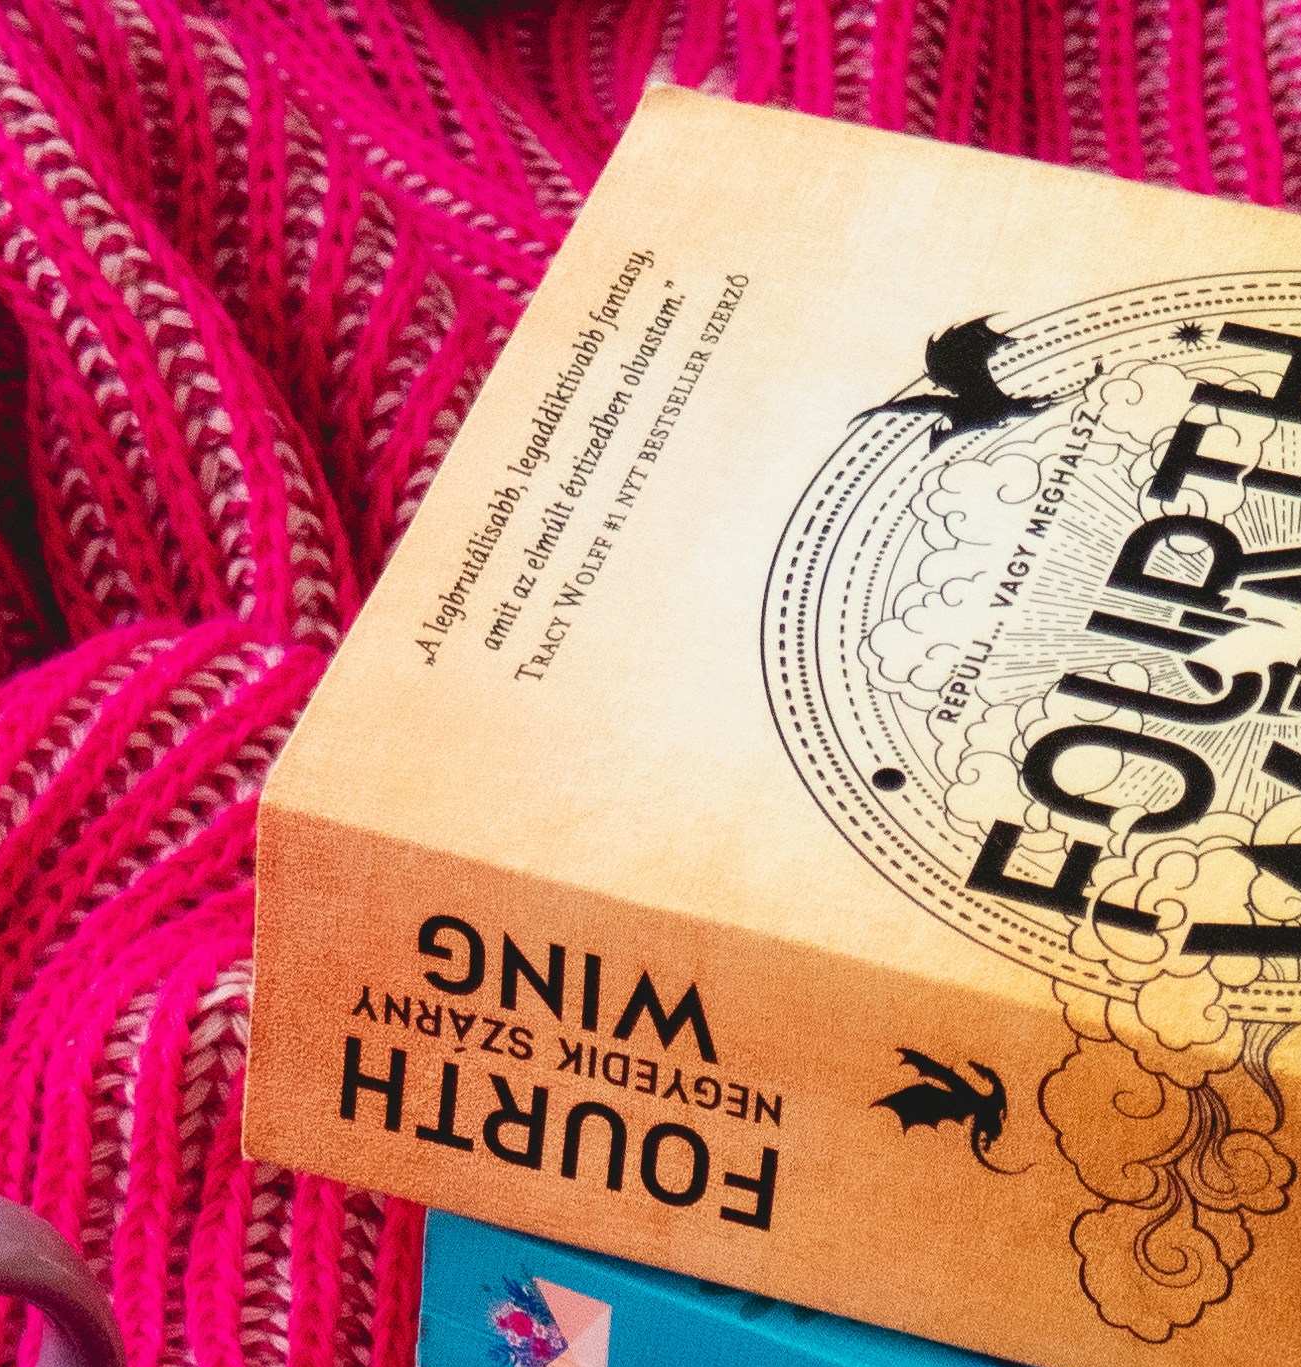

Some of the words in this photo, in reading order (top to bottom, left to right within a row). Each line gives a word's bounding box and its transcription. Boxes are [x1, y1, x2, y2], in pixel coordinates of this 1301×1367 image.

[699, 273, 750, 345] SZERZŐ
[421, 485, 529, 635] legbrutálisabb,
[506, 328, 606, 478] legaddiktívabb
[588, 249, 655, 332] fantasy,
[636, 350, 712, 464] BESTSELLER
[558, 390, 633, 499] évtizedben
[602, 512, 628, 532] #1
[614, 465, 649, 509] NYT
[989, 543, 1037, 608] VAGY
[1025, 409, 1103, 540] MEGHALSZ
[523, 501, 575, 571] elmúlt
[552, 535, 613, 608] WOLFF
[512, 573, 538, 600] az
[483, 601, 523, 652] amit
[513, 615, 572, 682] TRACY
[351, 985, 535, 1061] SZÁRNY
[416, 914, 718, 1065] WING
[558, 1036, 783, 1127] NEGYEDIK
[338, 1035, 780, 1231] FOURTH
